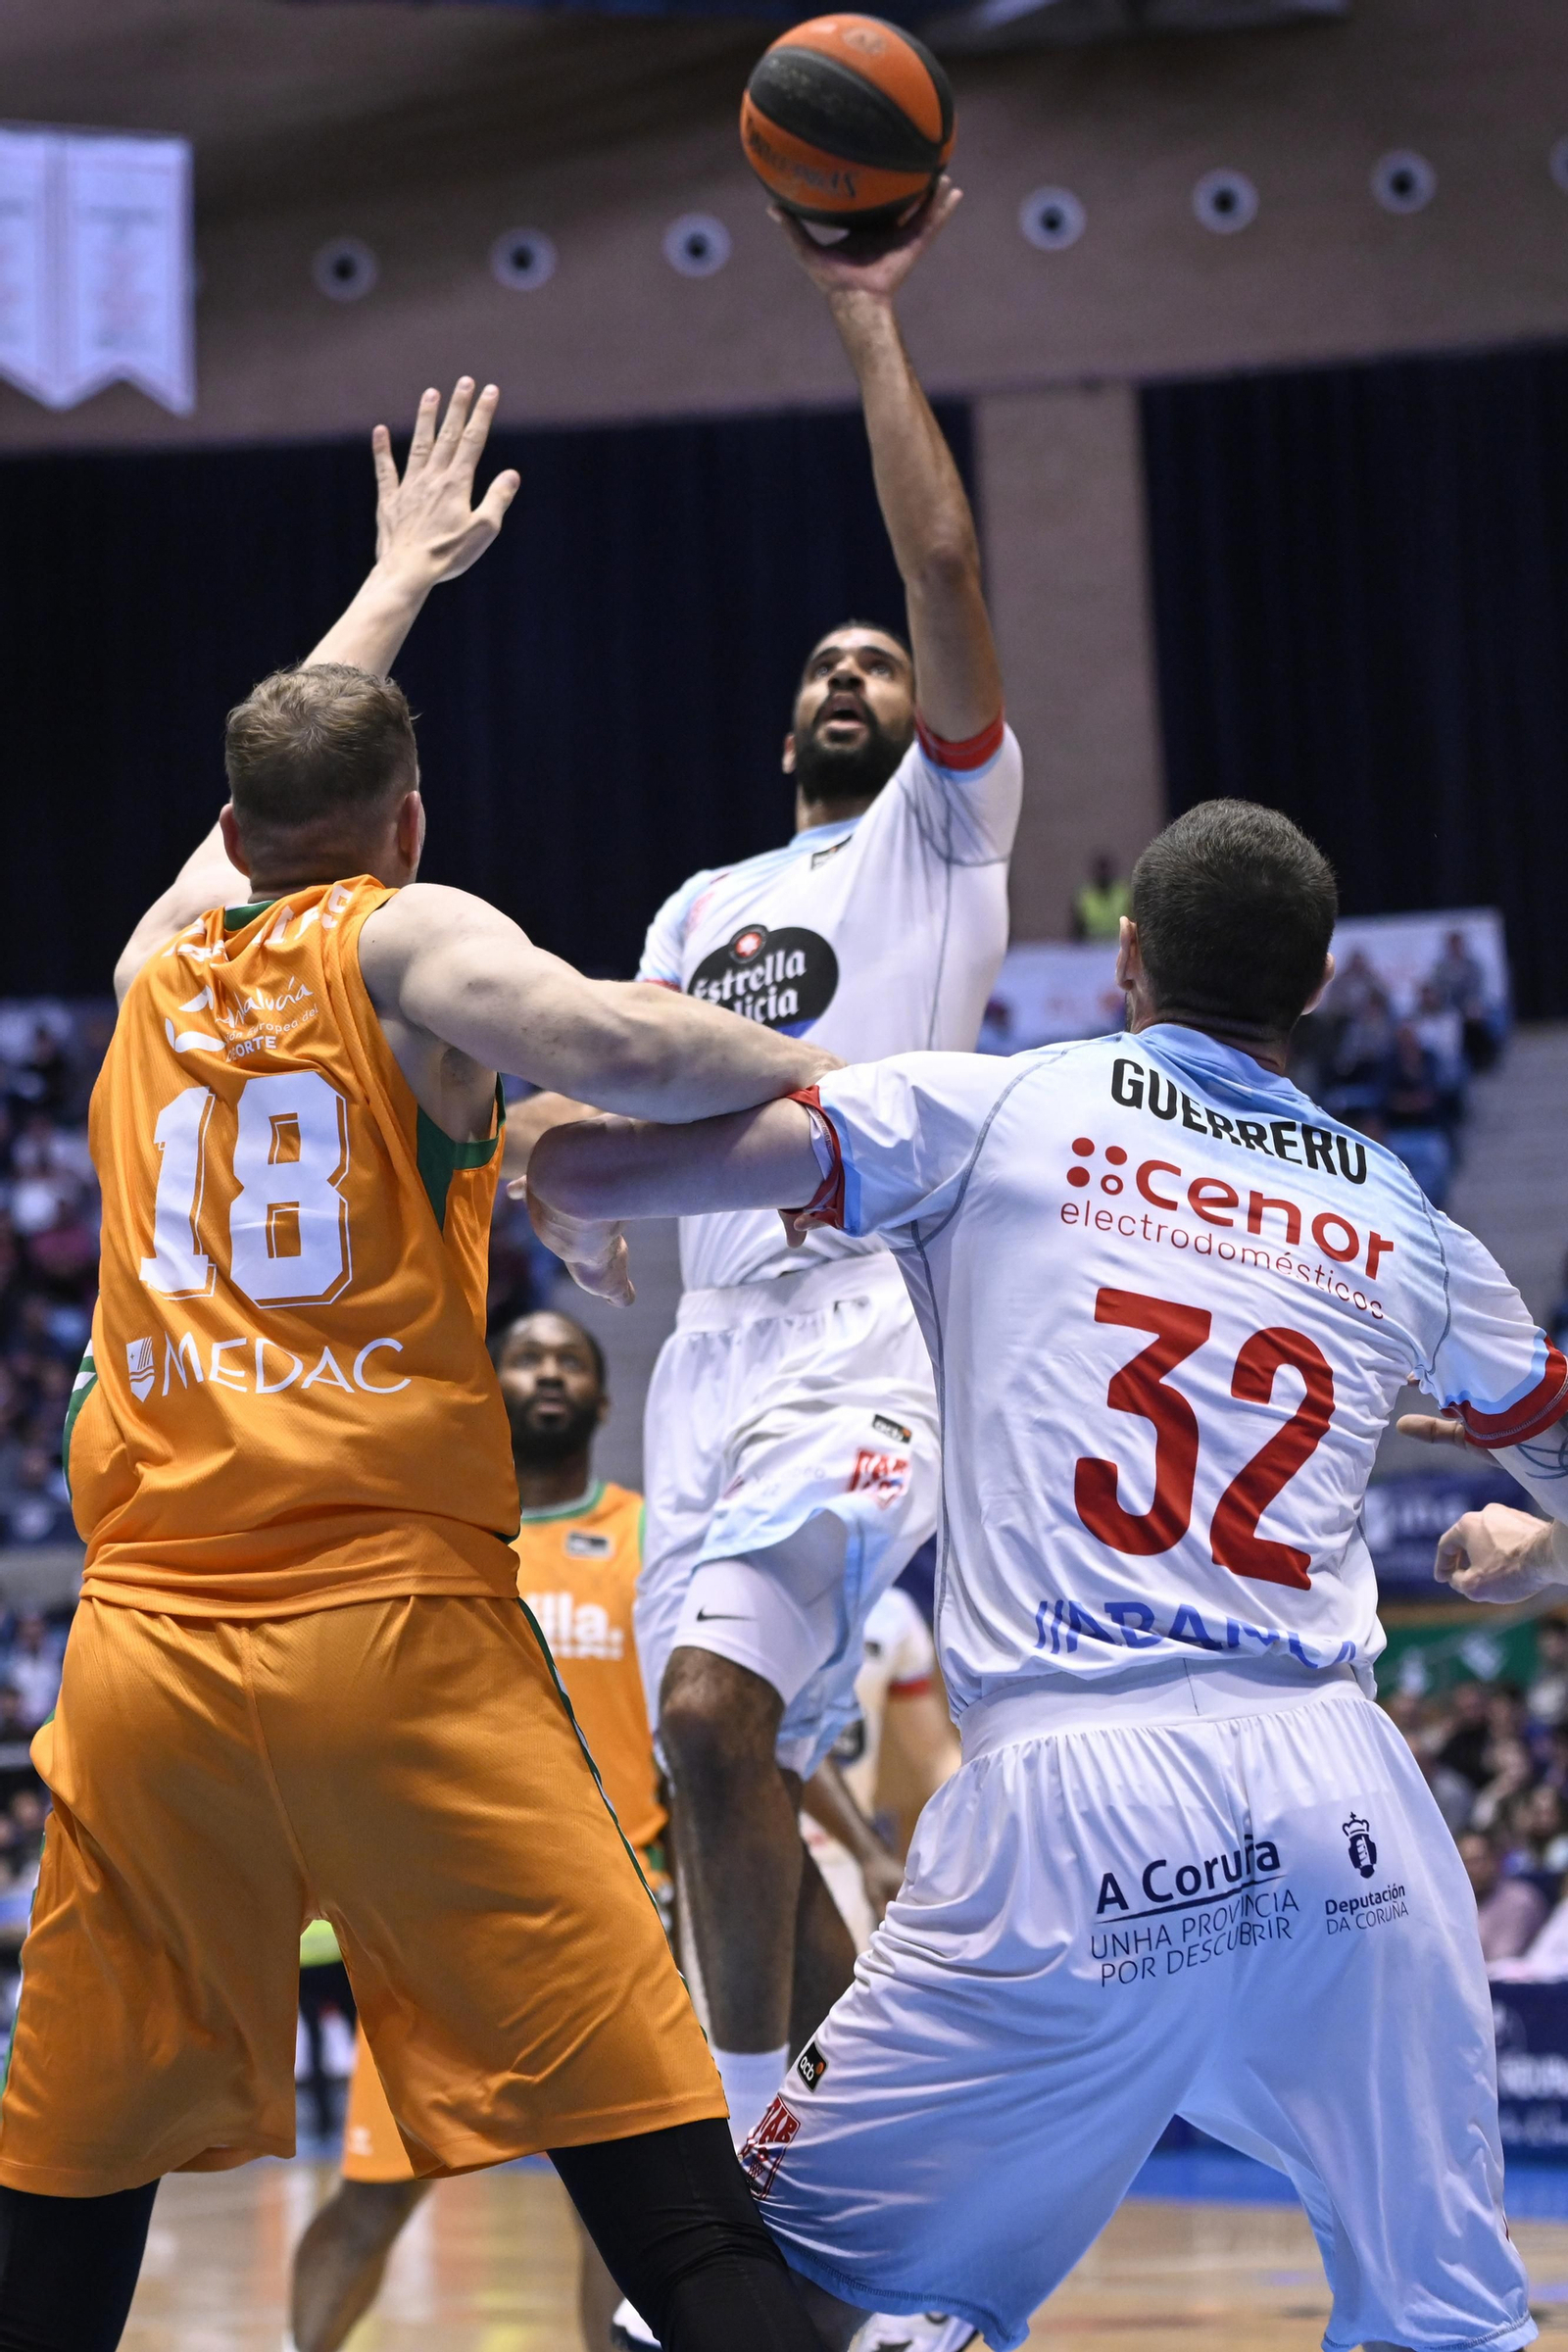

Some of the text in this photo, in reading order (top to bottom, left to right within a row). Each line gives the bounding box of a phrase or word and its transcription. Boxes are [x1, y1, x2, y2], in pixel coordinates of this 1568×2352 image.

[693, 949, 807, 1004] Estrella
[732, 984, 800, 1024] licia
[302, 1004, 318, 1022] del
[225, 1036, 277, 1063] DEORTE
[139, 1070, 352, 1309] 18
[1135, 1158, 1394, 1281] cenor
[1060, 1201, 1384, 1320] electrodomésticos
[162, 1331, 412, 1396] MEDAC
[1074, 1287, 1335, 1591] 32
[1097, 1872, 1129, 1915] A
[1325, 1883, 1406, 1916] Deputación
[1326, 1902, 1409, 1936] DA CORUÑA
[1091, 1889, 1300, 1960] UNHA PROVINCIA
[1101, 1916, 1293, 1987] POR DESCUBRIR
[800, 2055, 815, 2082] acb
